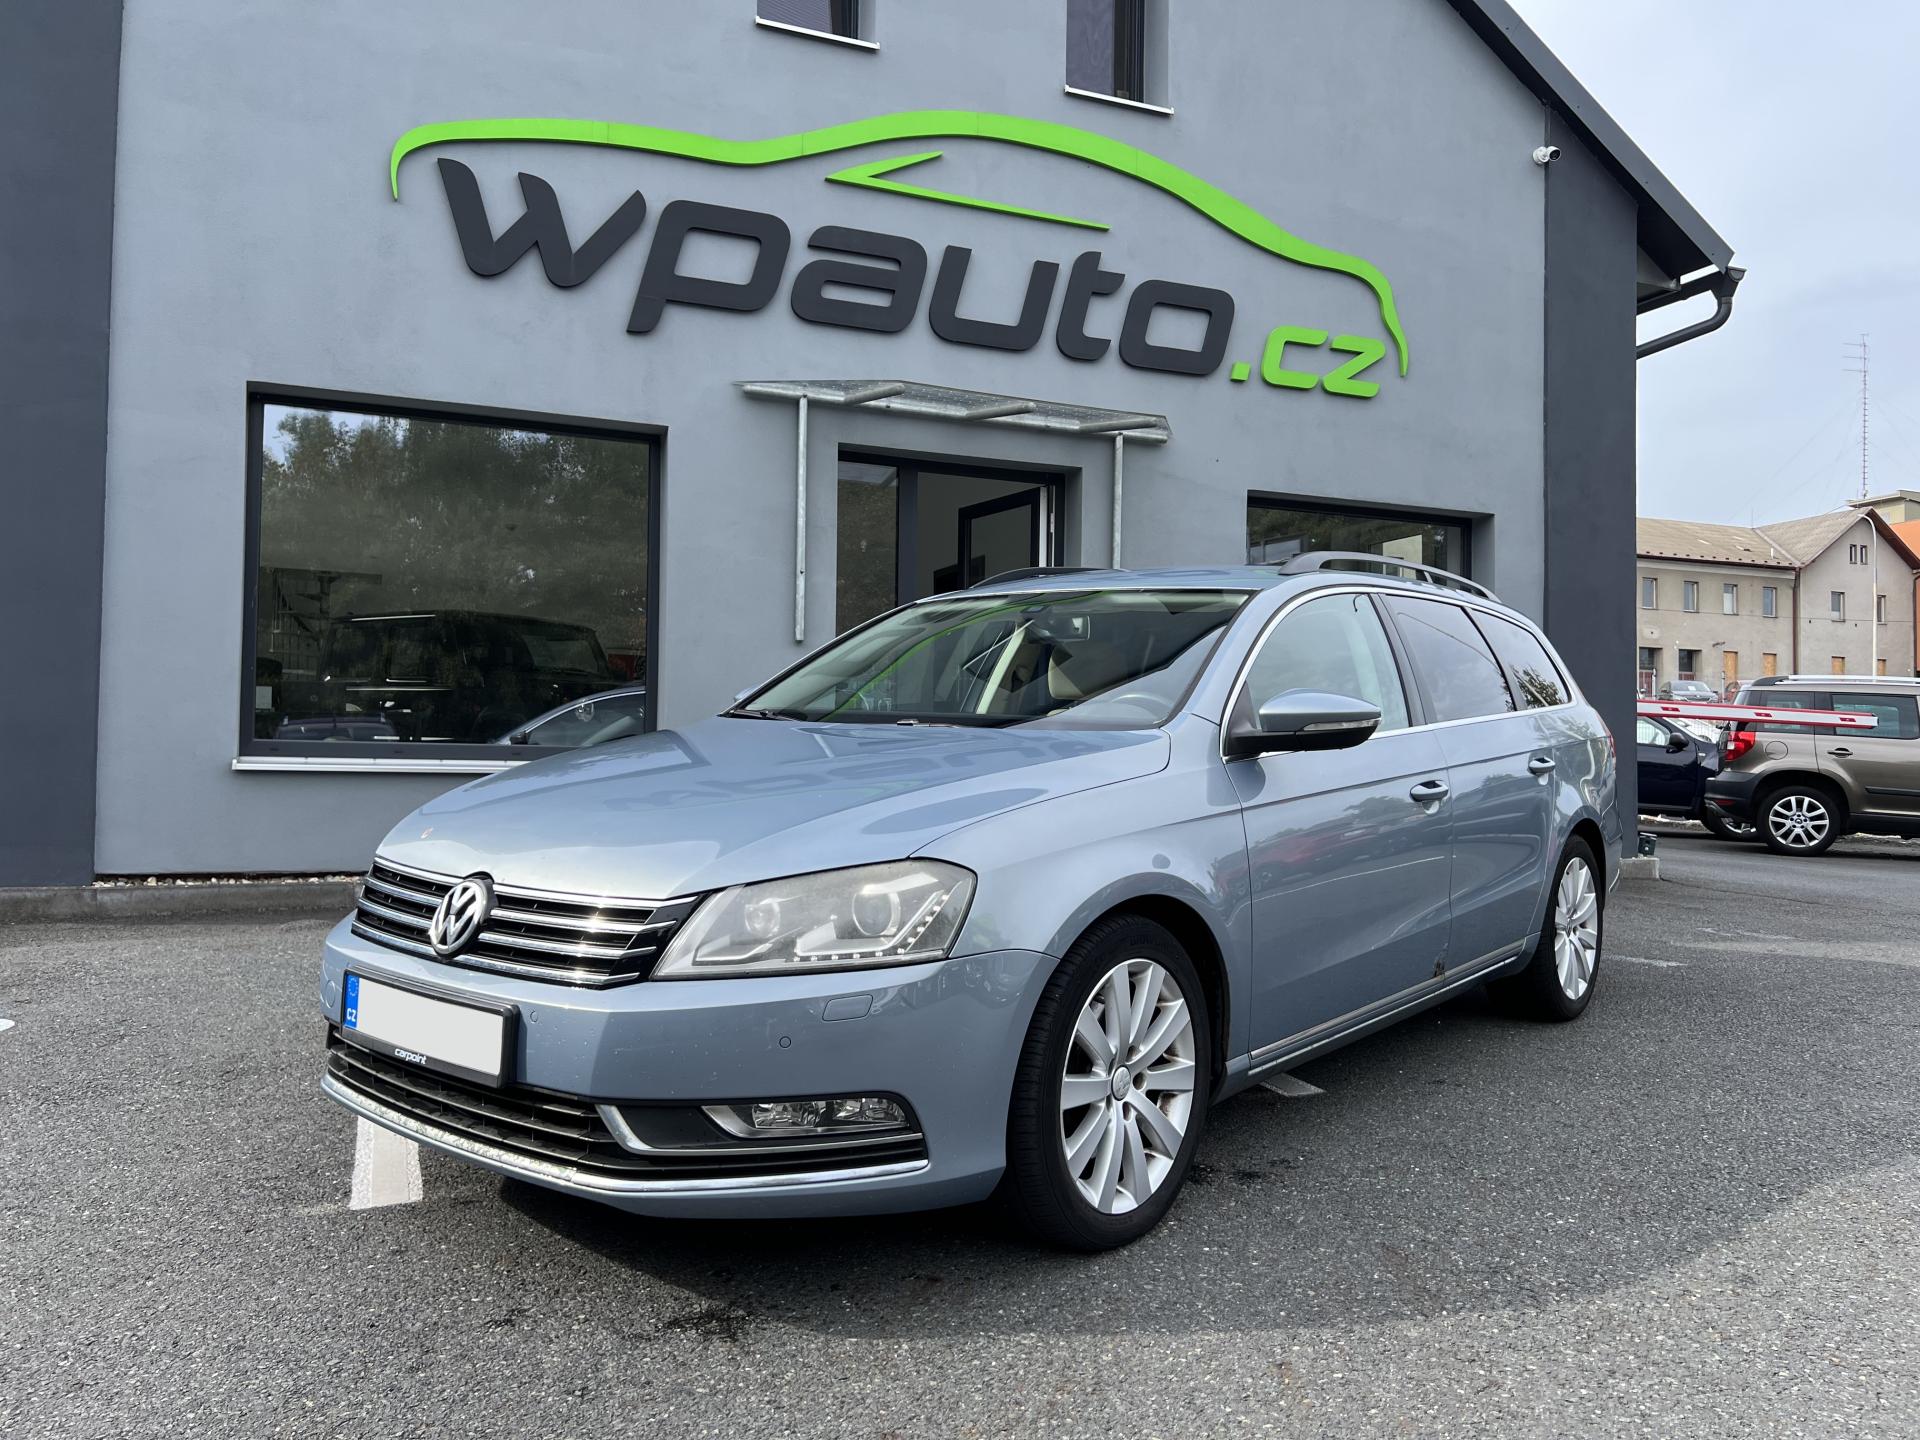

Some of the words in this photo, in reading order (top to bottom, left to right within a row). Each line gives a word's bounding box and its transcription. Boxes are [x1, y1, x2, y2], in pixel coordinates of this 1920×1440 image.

[437, 158, 1384, 400] wpauto.cz
[346, 1007, 357, 1022] CZ
[395, 1048, 426, 1064] carpoint
